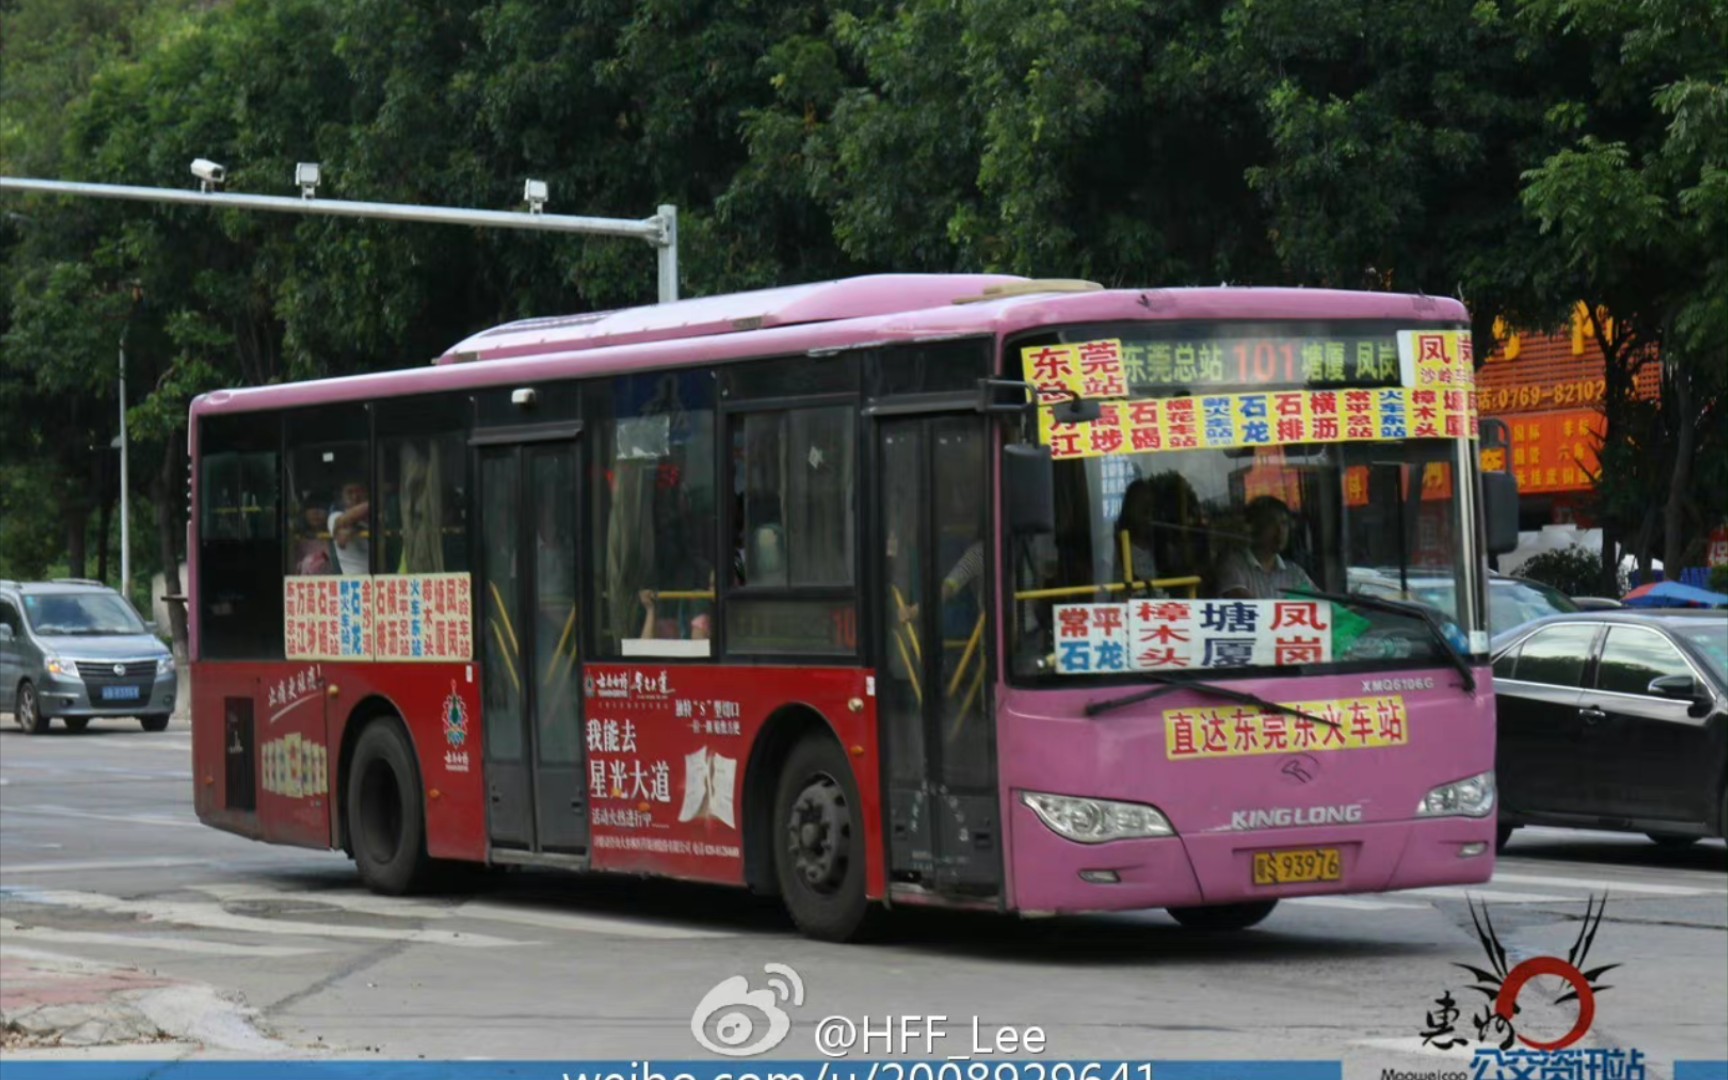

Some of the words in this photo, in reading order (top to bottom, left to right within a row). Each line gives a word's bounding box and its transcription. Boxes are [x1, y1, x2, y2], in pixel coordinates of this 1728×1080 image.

[1029, 341, 1120, 380] 东莞
[1122, 343, 1223, 383] 东莞总站
[1233, 342, 1295, 383] 101
[1238, 395, 1269, 443] 石龙
[1275, 393, 1304, 441] 石排
[1058, 607, 1122, 638] 常平
[1136, 601, 1191, 668] 樟木头
[1200, 601, 1259, 668] 塘厦
[1269, 601, 1328, 666] 凤岗
[1059, 640, 1124, 672] 石龙
[586, 718, 637, 753] 我能去
[1169, 699, 1402, 756] 直达东莞东火车站
[590, 759, 671, 803] 星光大道
